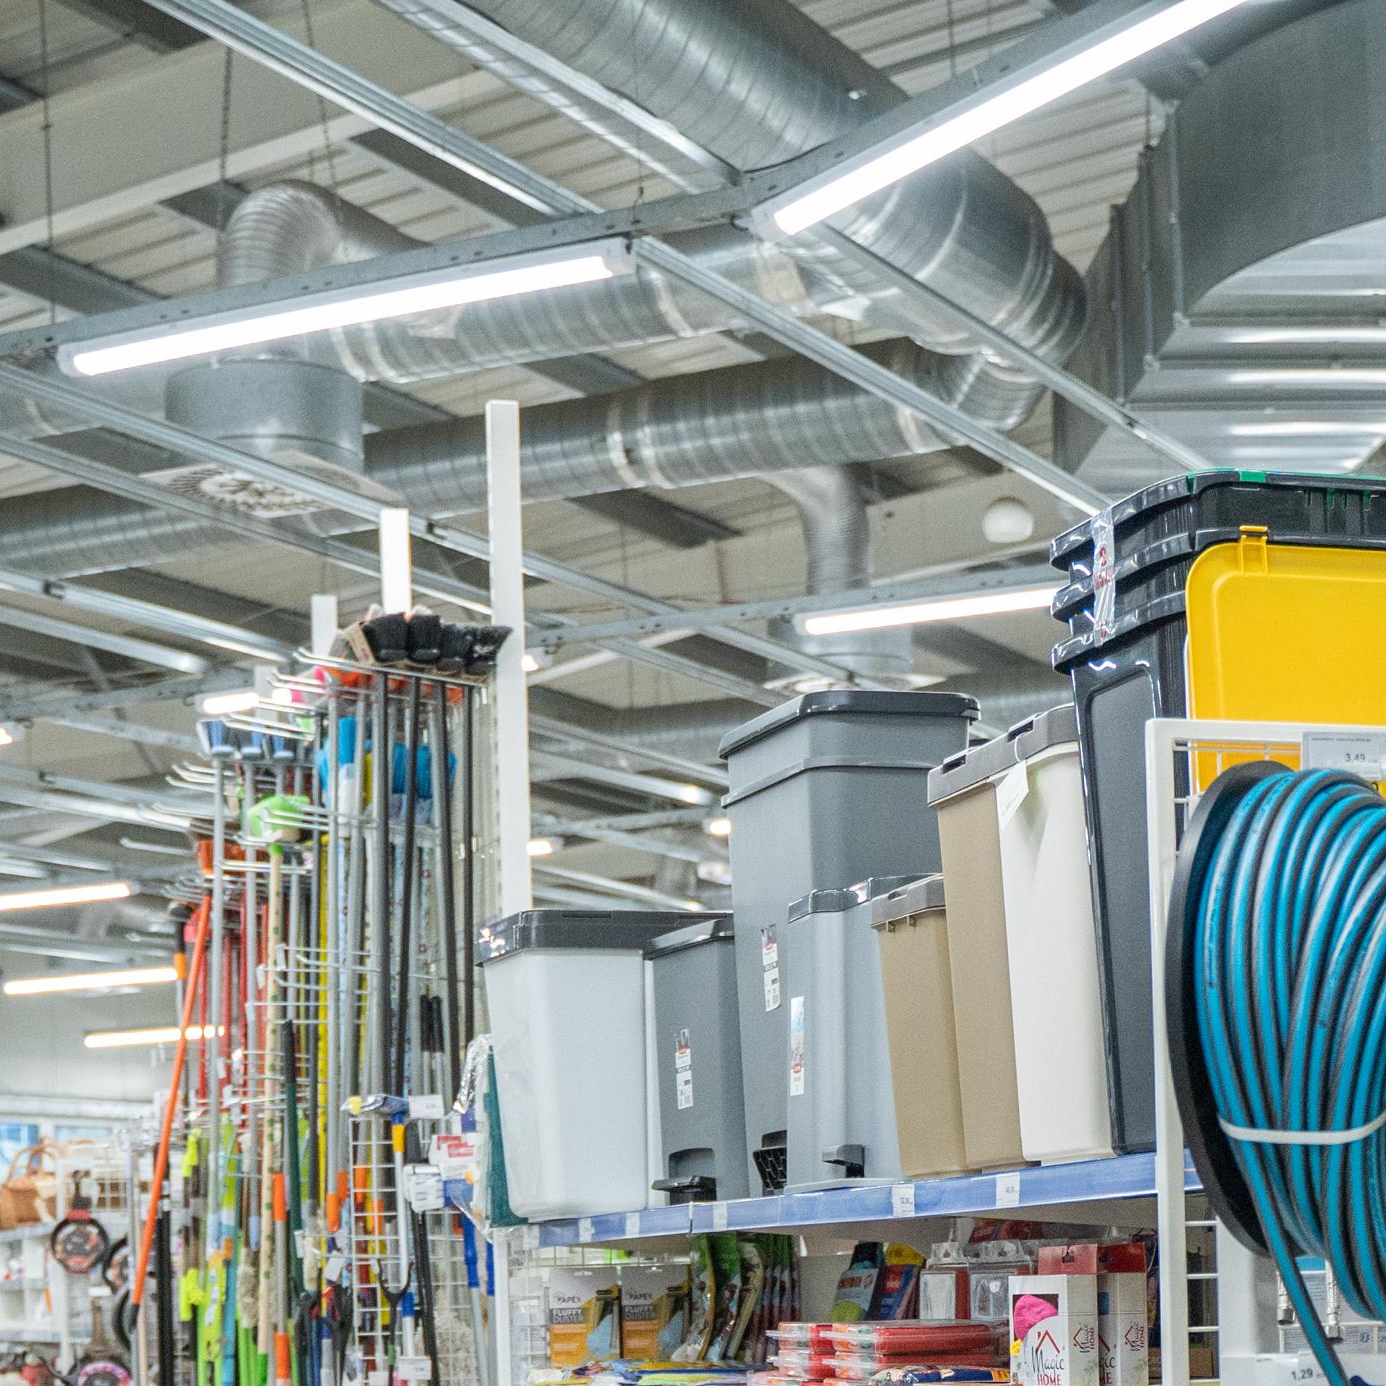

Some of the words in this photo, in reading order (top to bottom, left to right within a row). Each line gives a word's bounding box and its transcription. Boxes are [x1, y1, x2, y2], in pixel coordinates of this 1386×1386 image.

[1032, 1346, 1065, 1376] Magic
[1037, 1374, 1062, 1386] HOME
[1291, 1368, 1314, 1381] 1,29
